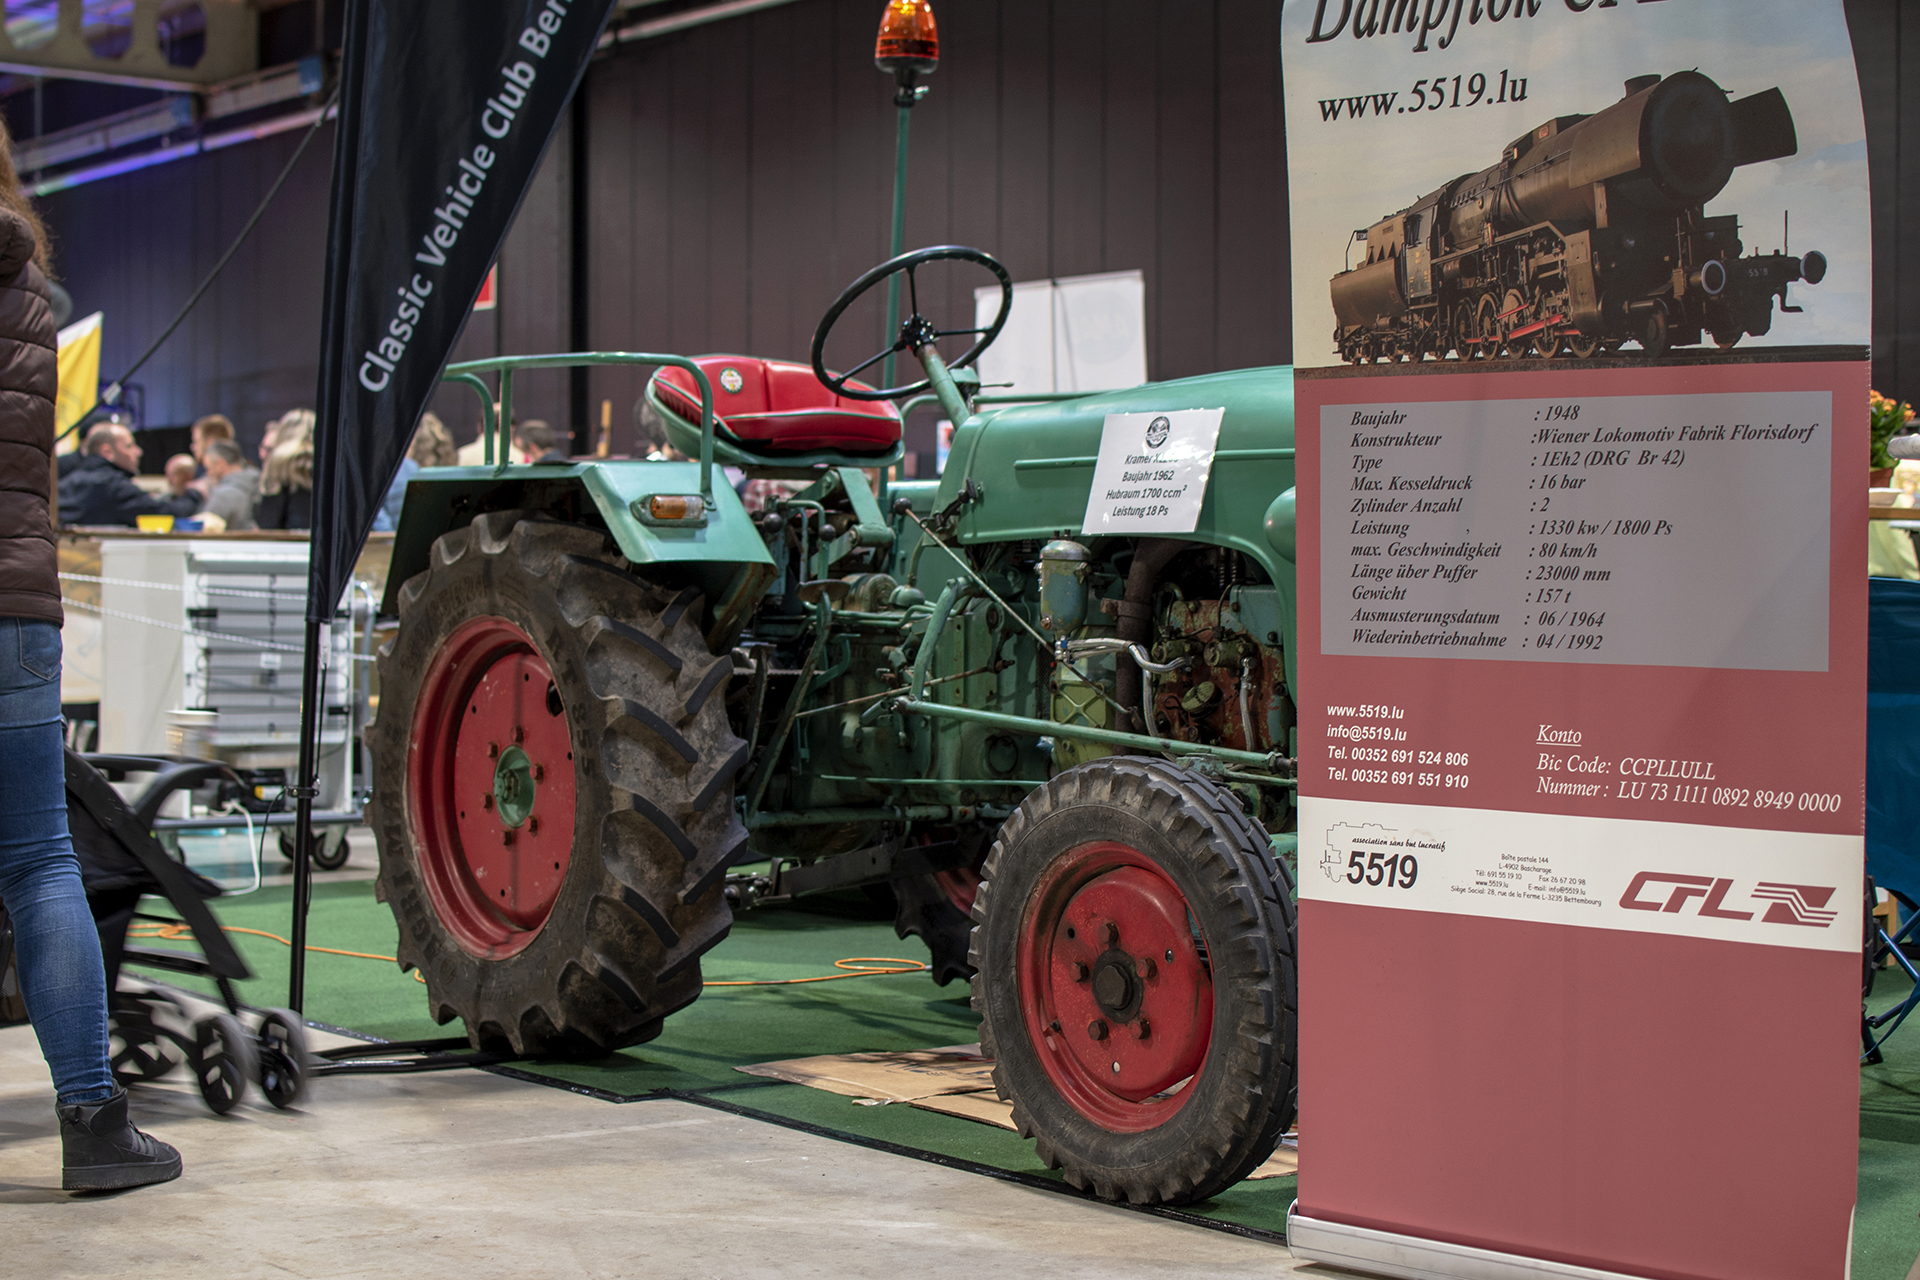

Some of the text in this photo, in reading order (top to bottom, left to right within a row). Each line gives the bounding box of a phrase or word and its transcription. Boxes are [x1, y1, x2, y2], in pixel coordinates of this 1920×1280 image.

[1305, 0, 1542, 53] Dampf
[1318, 68, 1529, 122] www.5519.lu
[358, 0, 573, 393] Classic Vehicle Club Ber
[1748, 267, 1769, 277] 559
[1350, 410, 1407, 429] Baujahr
[1544, 405, 1581, 421] 1948
[1350, 432, 1442, 447] Konstrukteur
[1592, 426, 1675, 443] Lokomotiv
[1678, 424, 1727, 442] Fabrik
[1730, 423, 1819, 444] Florisdorf
[1124, 454, 1153, 465] Kramer
[1352, 454, 1383, 473] Type
[1541, 451, 1580, 467] 1Eh2
[1584, 450, 1630, 469] (DRG
[1637, 450, 1659, 466] Br
[1661, 449, 1686, 468] 42)
[1122, 470, 1175, 484] Baujahr 1962
[1350, 476, 1384, 491] Max.
[1388, 475, 1474, 491] Kesseldruck
[1539, 474, 1557, 490] 16
[1560, 475, 1586, 490] bar
[1105, 489, 1140, 500] Hubraum
[1141, 488, 1162, 499] 1700
[1112, 505, 1169, 518] Leistung 18 Ps
[1350, 498, 1408, 516] Zylinder
[1410, 497, 1463, 514] Anzahl
[1539, 497, 1551, 512] 2
[1350, 520, 1411, 538] Leistung
[1539, 520, 1575, 535] 1330
[1577, 520, 1599, 535] kw
[1612, 519, 1651, 535] 1800
[1653, 519, 1673, 536] Ps
[1350, 544, 1382, 557] max.
[1388, 541, 1502, 561] Geschwindigkeit
[1538, 542, 1557, 558] 80
[1559, 542, 1597, 558] km/h
[1350, 563, 1393, 582] Länge
[1396, 564, 1430, 579] über
[1432, 564, 1479, 583] Puffer
[1535, 565, 1580, 581] 23000
[1582, 570, 1611, 581] mm
[1352, 585, 1407, 601] Gewicht
[1535, 588, 1563, 604] 157
[1564, 590, 1571, 604] t
[1350, 607, 1500, 627] Ausmusterungsdatum
[1538, 611, 1556, 626] 06
[1568, 611, 1606, 627] 1964
[1352, 628, 1507, 648] Wiederinbetriebnahme
[1536, 633, 1555, 649] 04
[1566, 634, 1604, 650] 1992
[1326, 704, 1405, 719] www.5519.lu
[572, 703, 596, 777] 855
[1326, 724, 1407, 742] info@5519.lu
[1536, 724, 1582, 745] Konto
[1327, 745, 1469, 767] Tel. 00352 691 524 806
[1536, 753, 1716, 781] Bic Code: CCPLLULL
[1327, 766, 1469, 789] Tel. 00352 691 551 910
[1617, 781, 1646, 800] LU
[1650, 783, 1668, 801] 73
[1673, 784, 1707, 805] 1111
[1712, 787, 1750, 808] 0892
[1753, 790, 1794, 810] 8949
[1797, 792, 1842, 813] 0000
[1352, 836, 1446, 852] association sans but lucratif
[1346, 850, 1419, 889] 5519
[1520, 864, 1552, 875] Bascharage
[1475, 880, 1509, 888] www.5519.lu
[1548, 885, 1586, 895] info@5519.lu
[1522, 891, 1541, 900] Ferme
[1541, 893, 1563, 902] L-3235
[1563, 895, 1602, 907] Bettembourg
[1618, 870, 1755, 921] CFL
